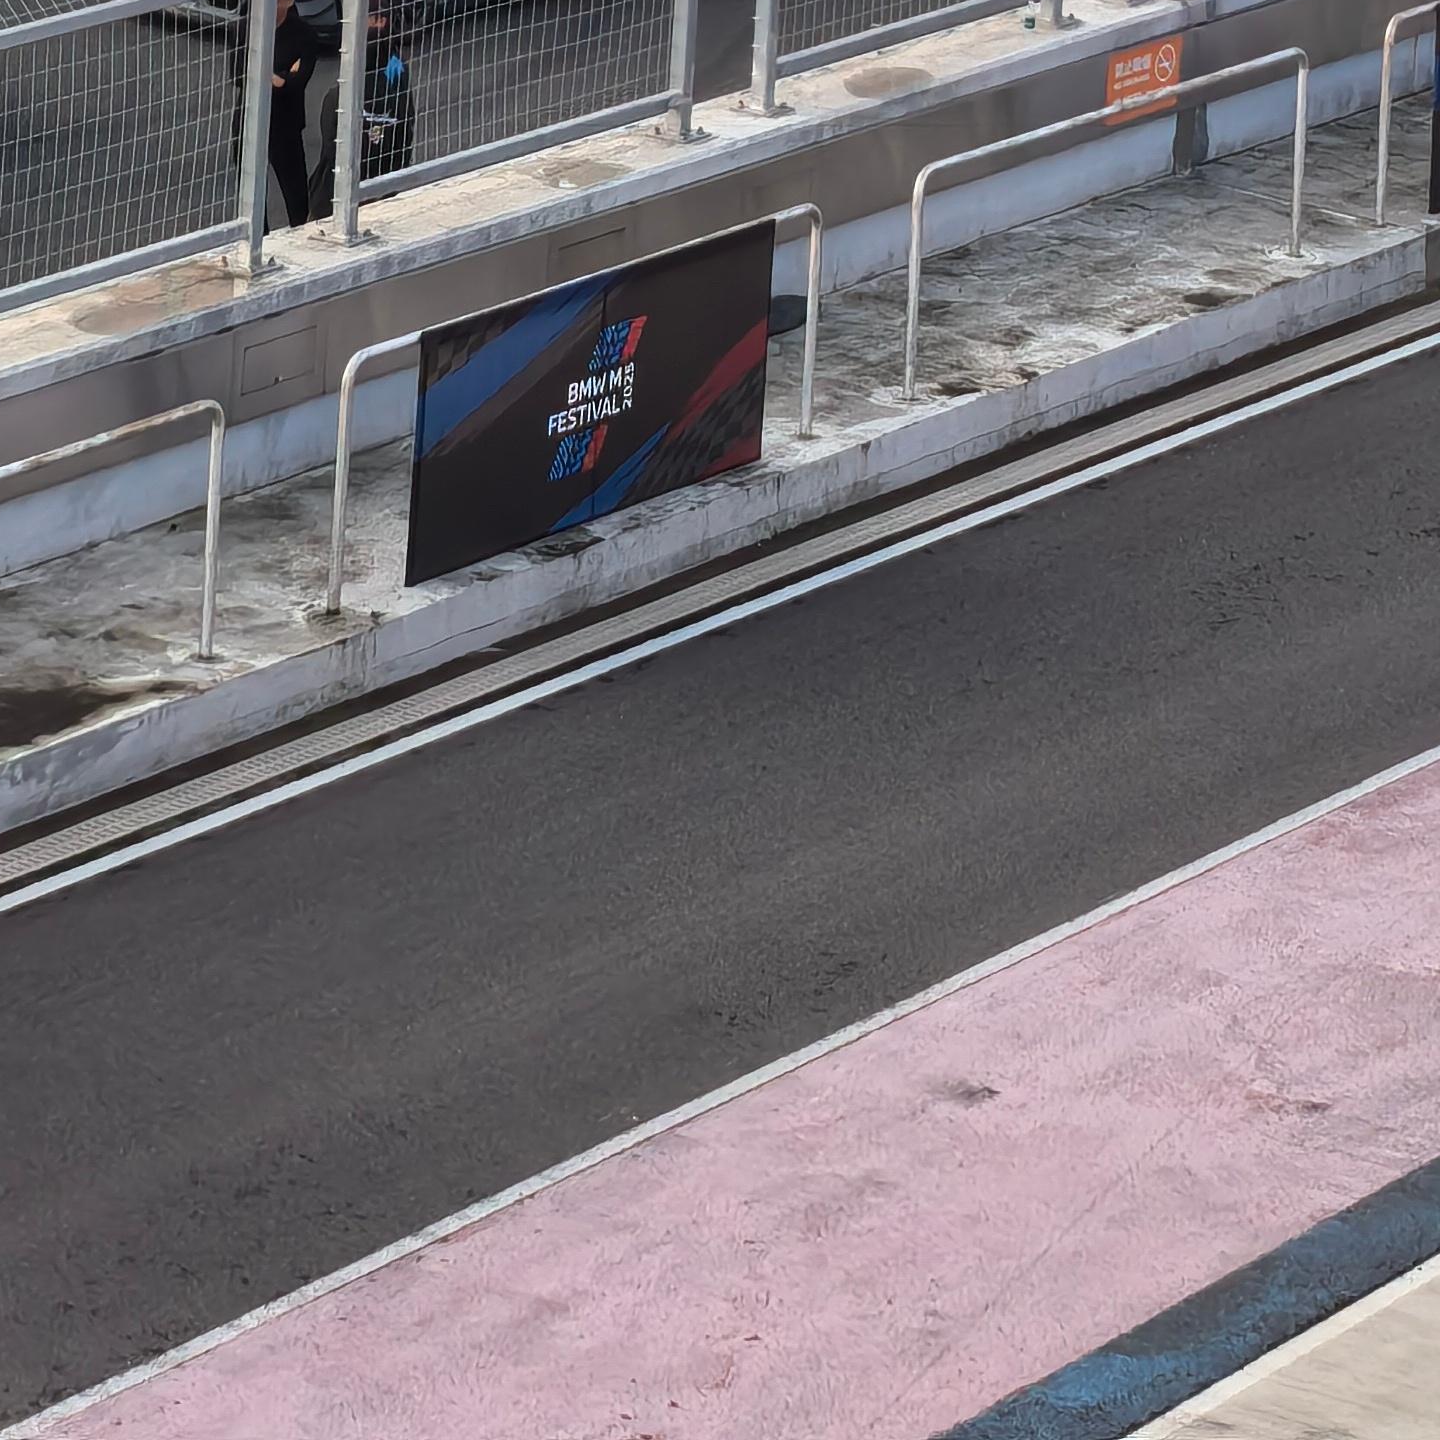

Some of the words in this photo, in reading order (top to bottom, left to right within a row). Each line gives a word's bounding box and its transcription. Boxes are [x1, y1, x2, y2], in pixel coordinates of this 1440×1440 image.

[567, 371, 607, 406] BMW
[609, 366, 623, 391] M
[622, 361, 635, 410] 2025
[548, 393, 621, 437] FESTIVAL
